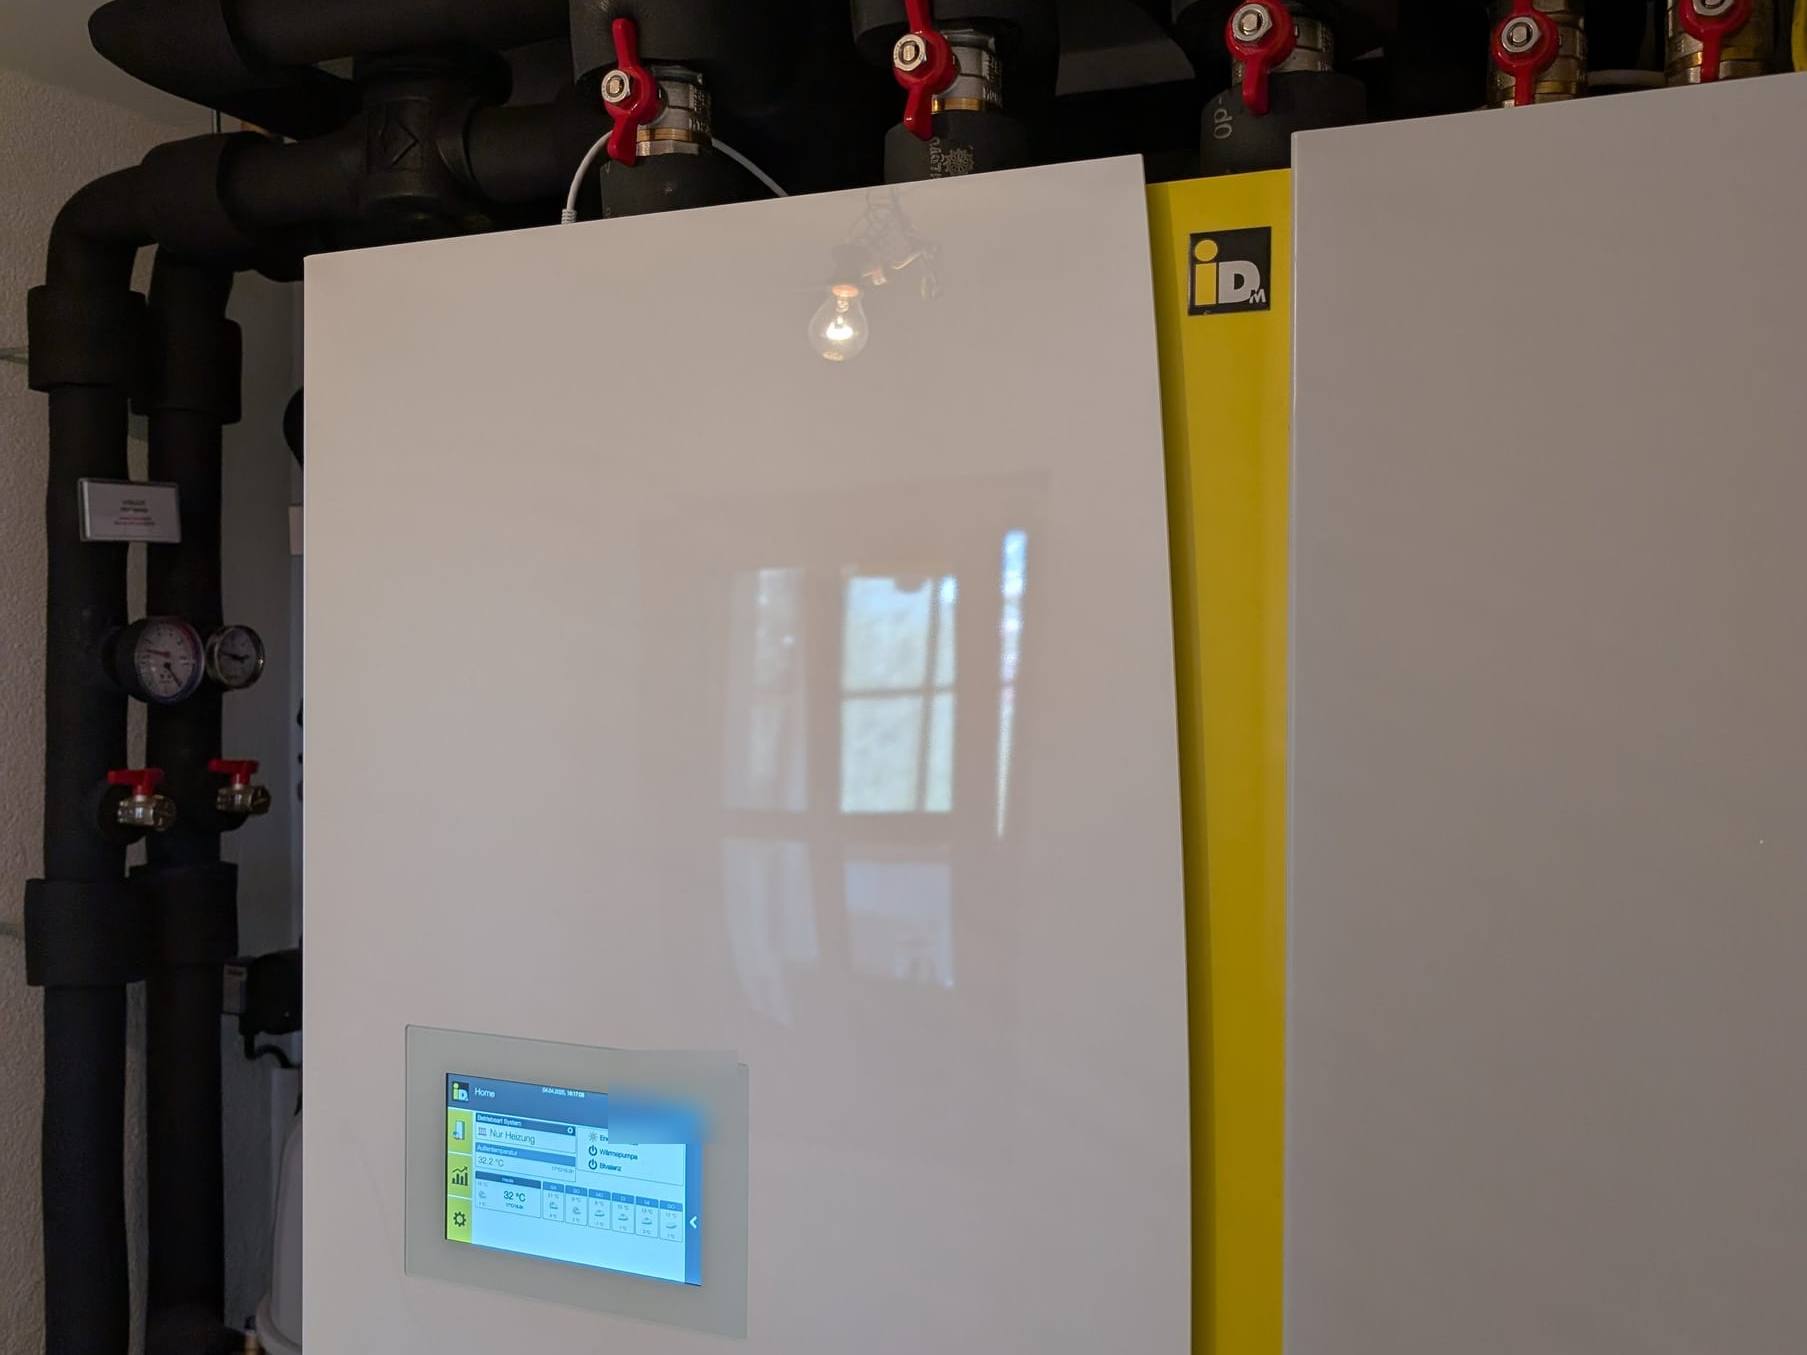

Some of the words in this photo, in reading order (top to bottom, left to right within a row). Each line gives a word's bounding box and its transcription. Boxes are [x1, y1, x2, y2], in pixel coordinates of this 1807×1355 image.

[474, 1087, 496, 1098] Home
[490, 1128, 503, 1138] Nur
[505, 1131, 536, 1145] Heizung
[478, 1156, 494, 1167] 32.2
[503, 1190, 514, 1200] 32
[515, 1192, 526, 1202] °C
